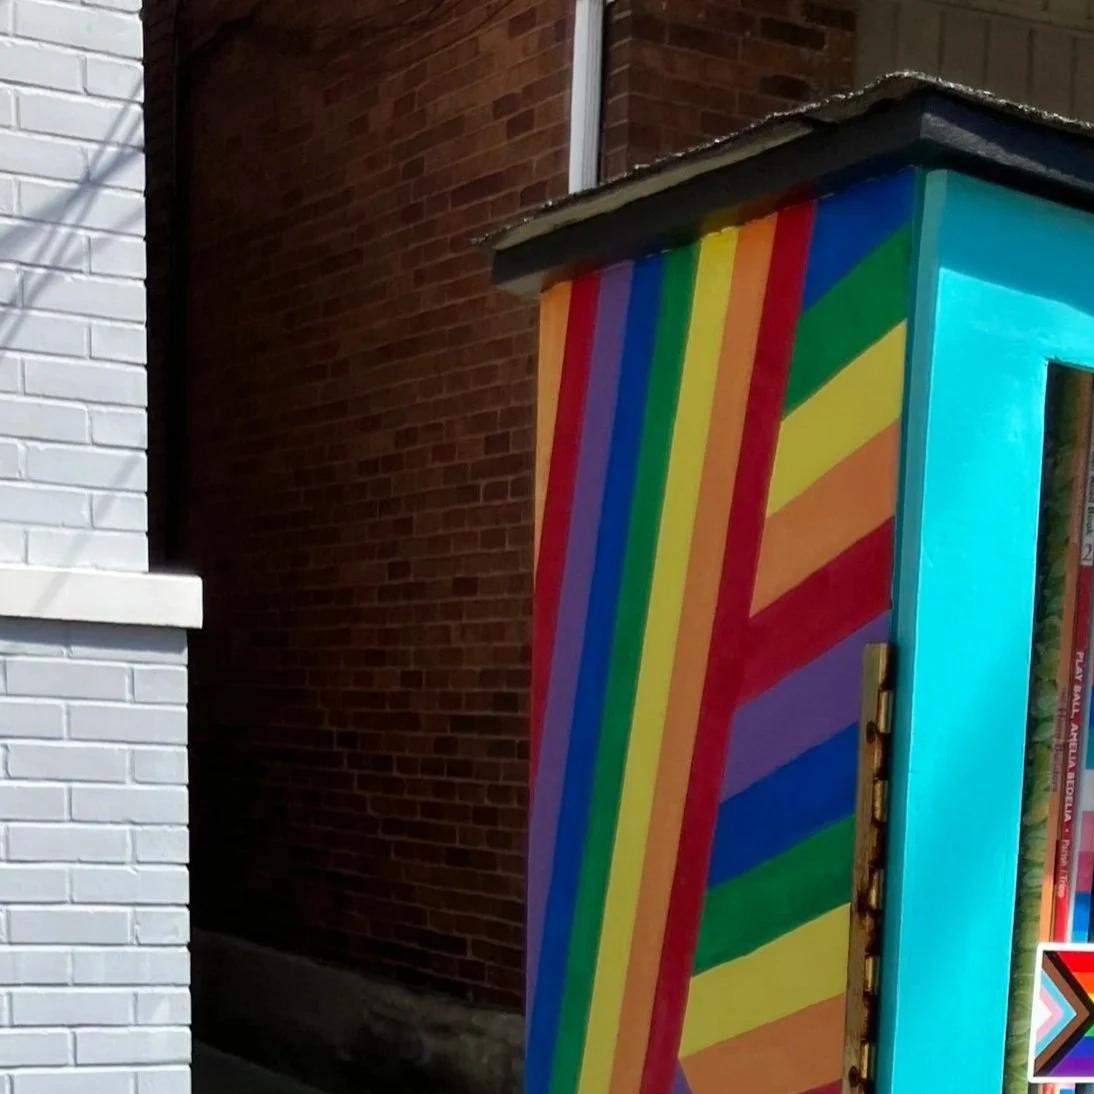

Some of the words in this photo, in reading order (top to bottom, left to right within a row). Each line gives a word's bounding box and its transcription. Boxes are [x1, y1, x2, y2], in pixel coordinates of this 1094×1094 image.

[1083, 547, 1093, 562] 2
[1073, 651, 1085, 681] PLAY
[1070, 684, 1082, 719] BALL,
[1066, 722, 1078, 768] AMELIA
[1063, 769, 1076, 822] BEDELIA
